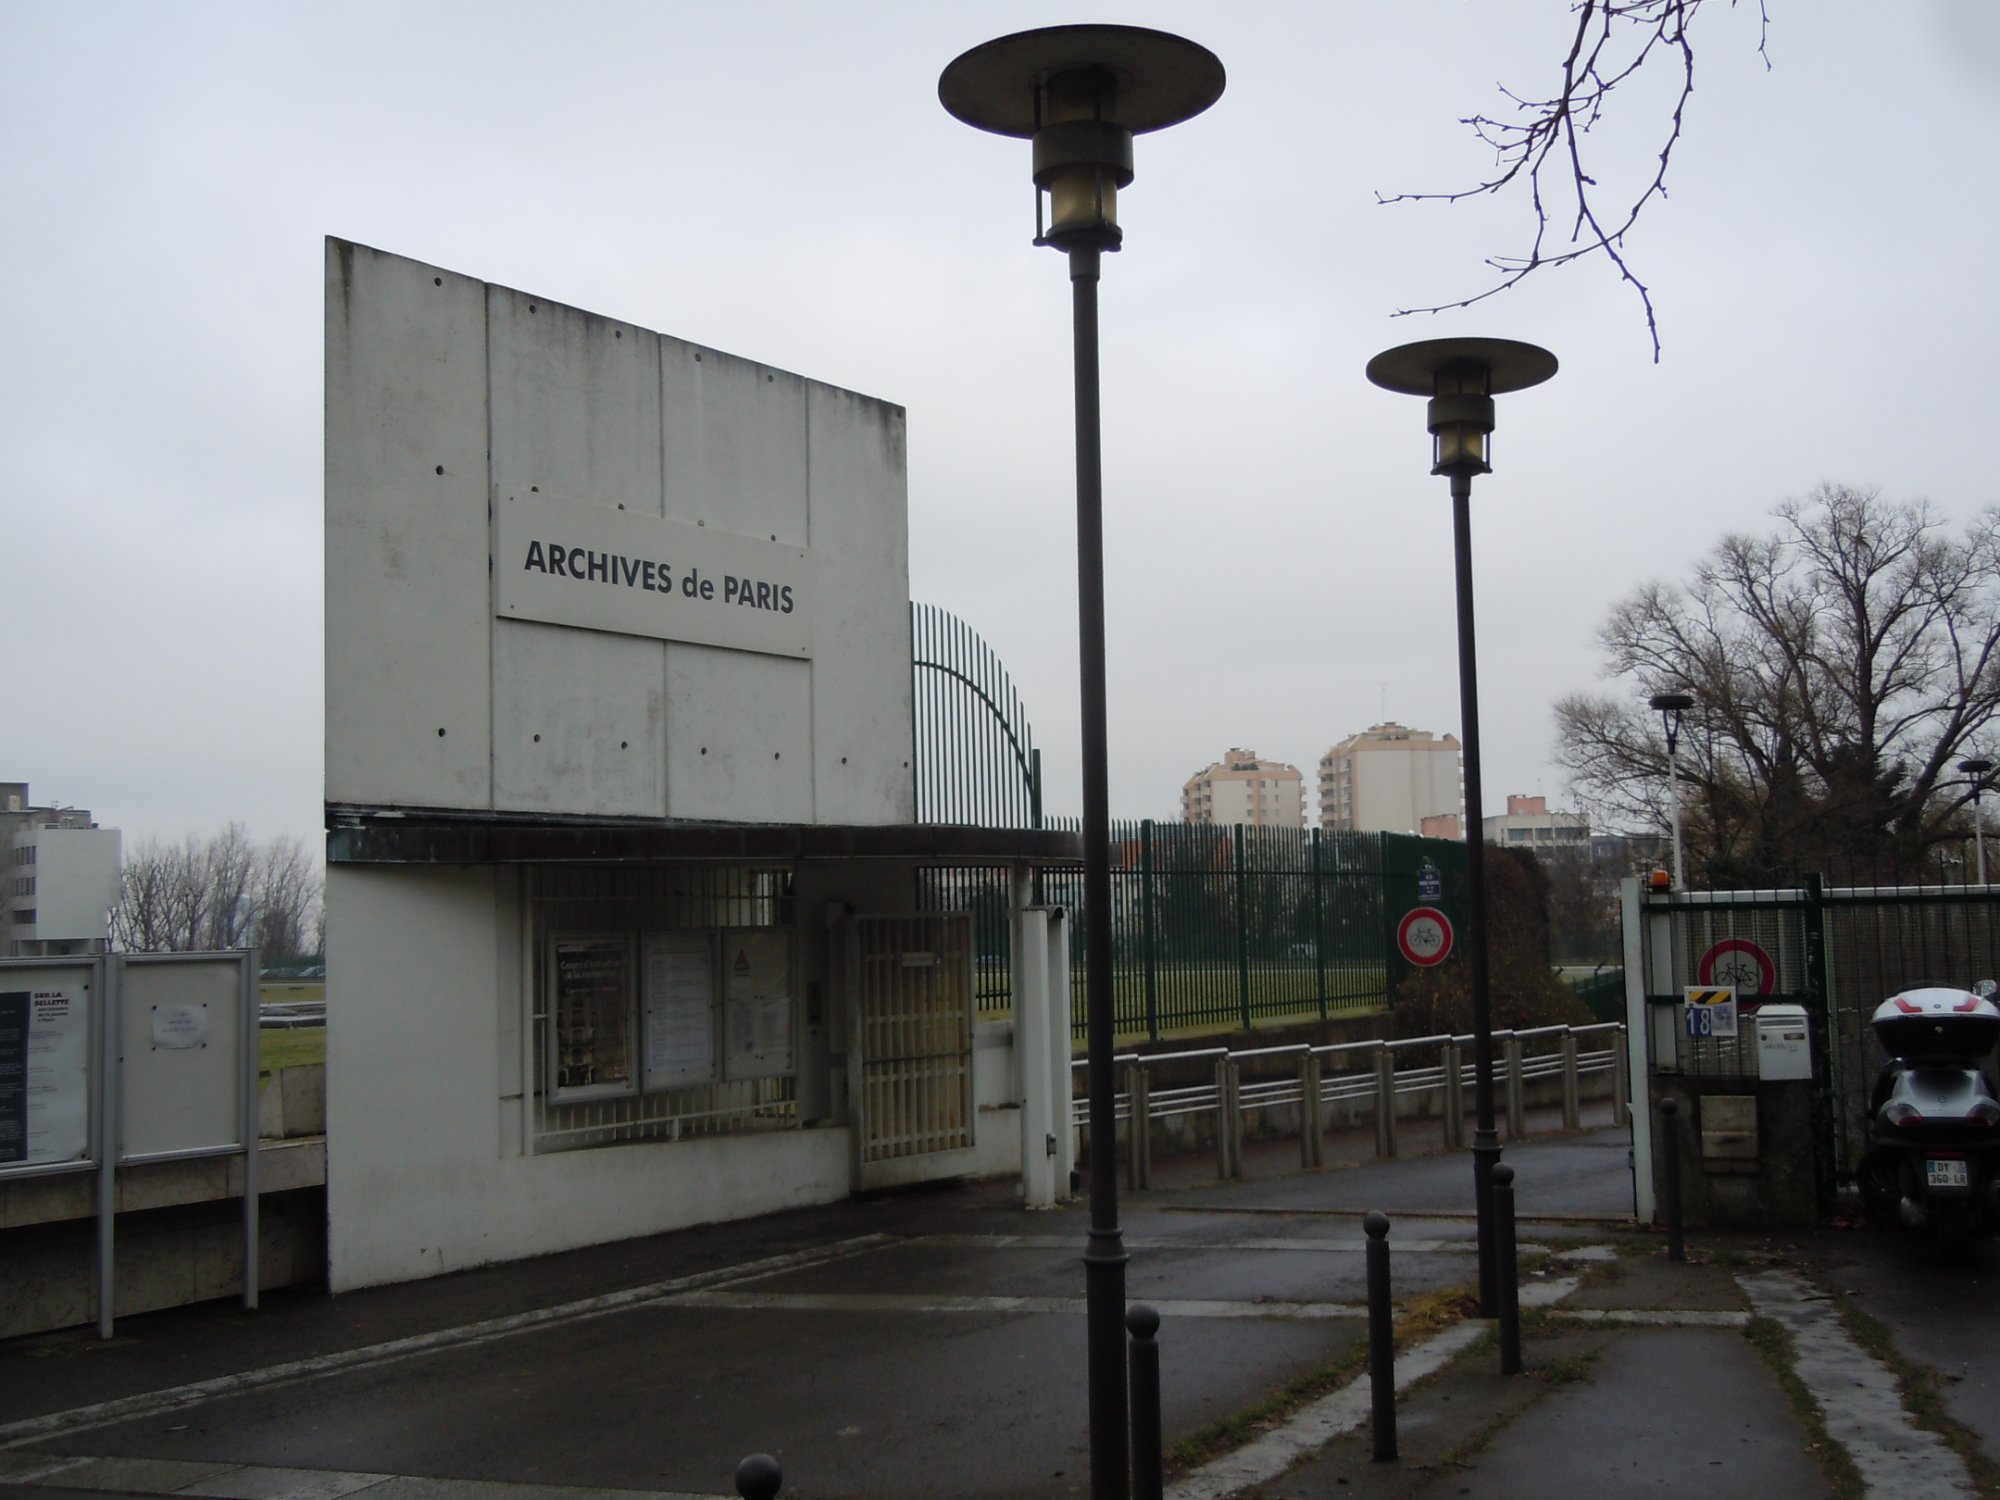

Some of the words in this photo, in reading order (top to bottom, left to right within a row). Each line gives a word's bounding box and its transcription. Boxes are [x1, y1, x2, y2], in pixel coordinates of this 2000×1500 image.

[524, 540, 672, 594] ARCHIVES
[682, 568, 714, 601] de
[724, 575, 794, 614] PARIS
[1686, 1008, 1710, 1035] 18
